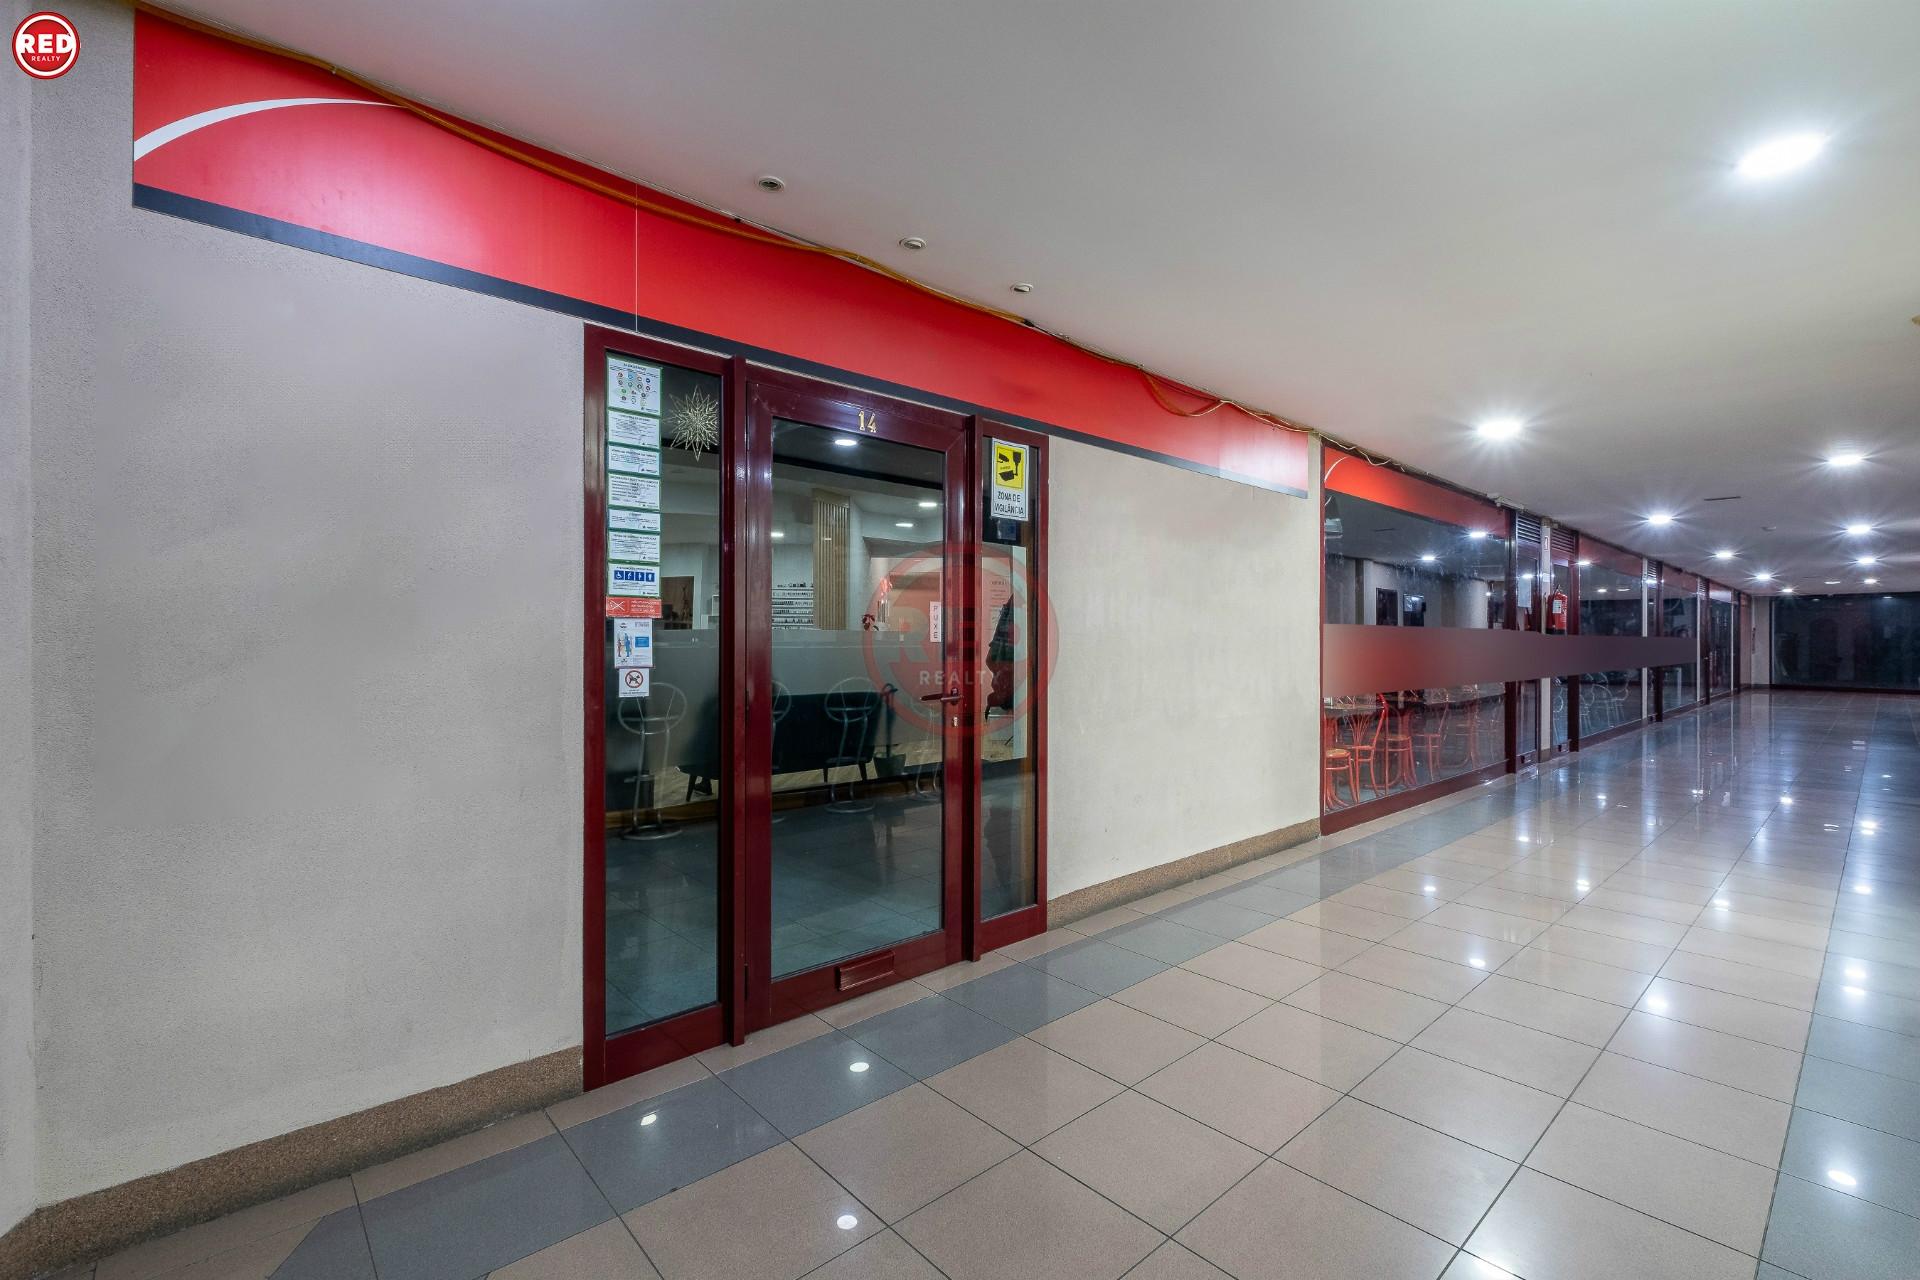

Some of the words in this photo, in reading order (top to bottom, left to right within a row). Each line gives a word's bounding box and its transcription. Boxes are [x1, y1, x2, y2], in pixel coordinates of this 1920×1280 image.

[858, 410, 877, 433] 14
[997, 490, 1012, 501] ZONA
[1013, 493, 1021, 503] DE
[994, 502, 1025, 515] VIGILÂNCIA
[932, 604, 940, 639] PUXE
